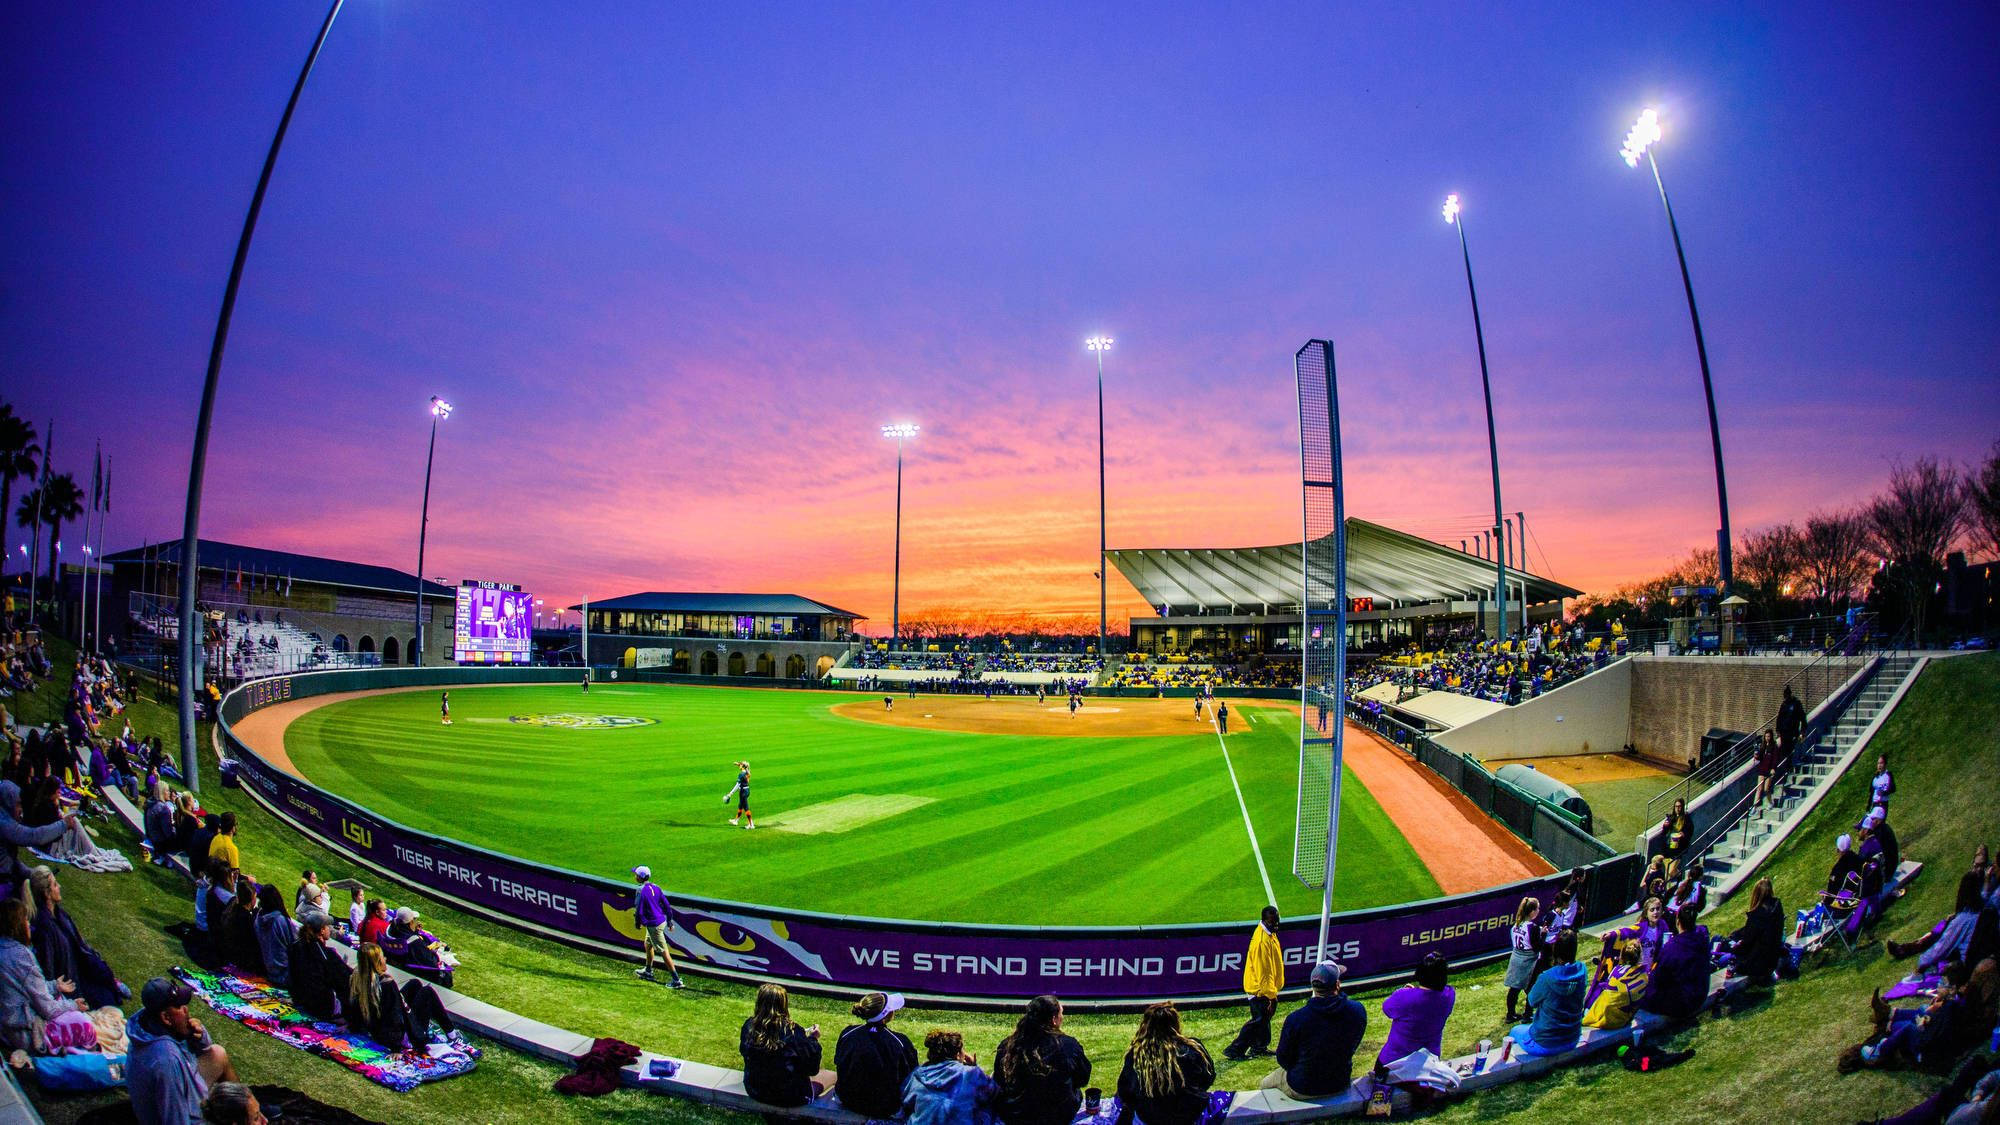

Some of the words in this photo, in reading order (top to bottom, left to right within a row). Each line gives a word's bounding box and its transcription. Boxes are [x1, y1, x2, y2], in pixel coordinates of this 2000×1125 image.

[478, 581, 495, 590] TIGER
[499, 583, 514, 592] PARK
[246, 678, 291, 709] TIGERS
[342, 818, 373, 849] LSU
[393, 844, 433, 872] TIGER
[437, 860, 482, 888] PARK
[488, 875, 578, 916] TERRACE
[849, 947, 900, 969] WE
[913, 952, 1027, 976] STAND
[1040, 957, 1164, 977] BEHIND
[1175, 952, 1242, 974] OUR
[1284, 940, 1360, 966] GERS
